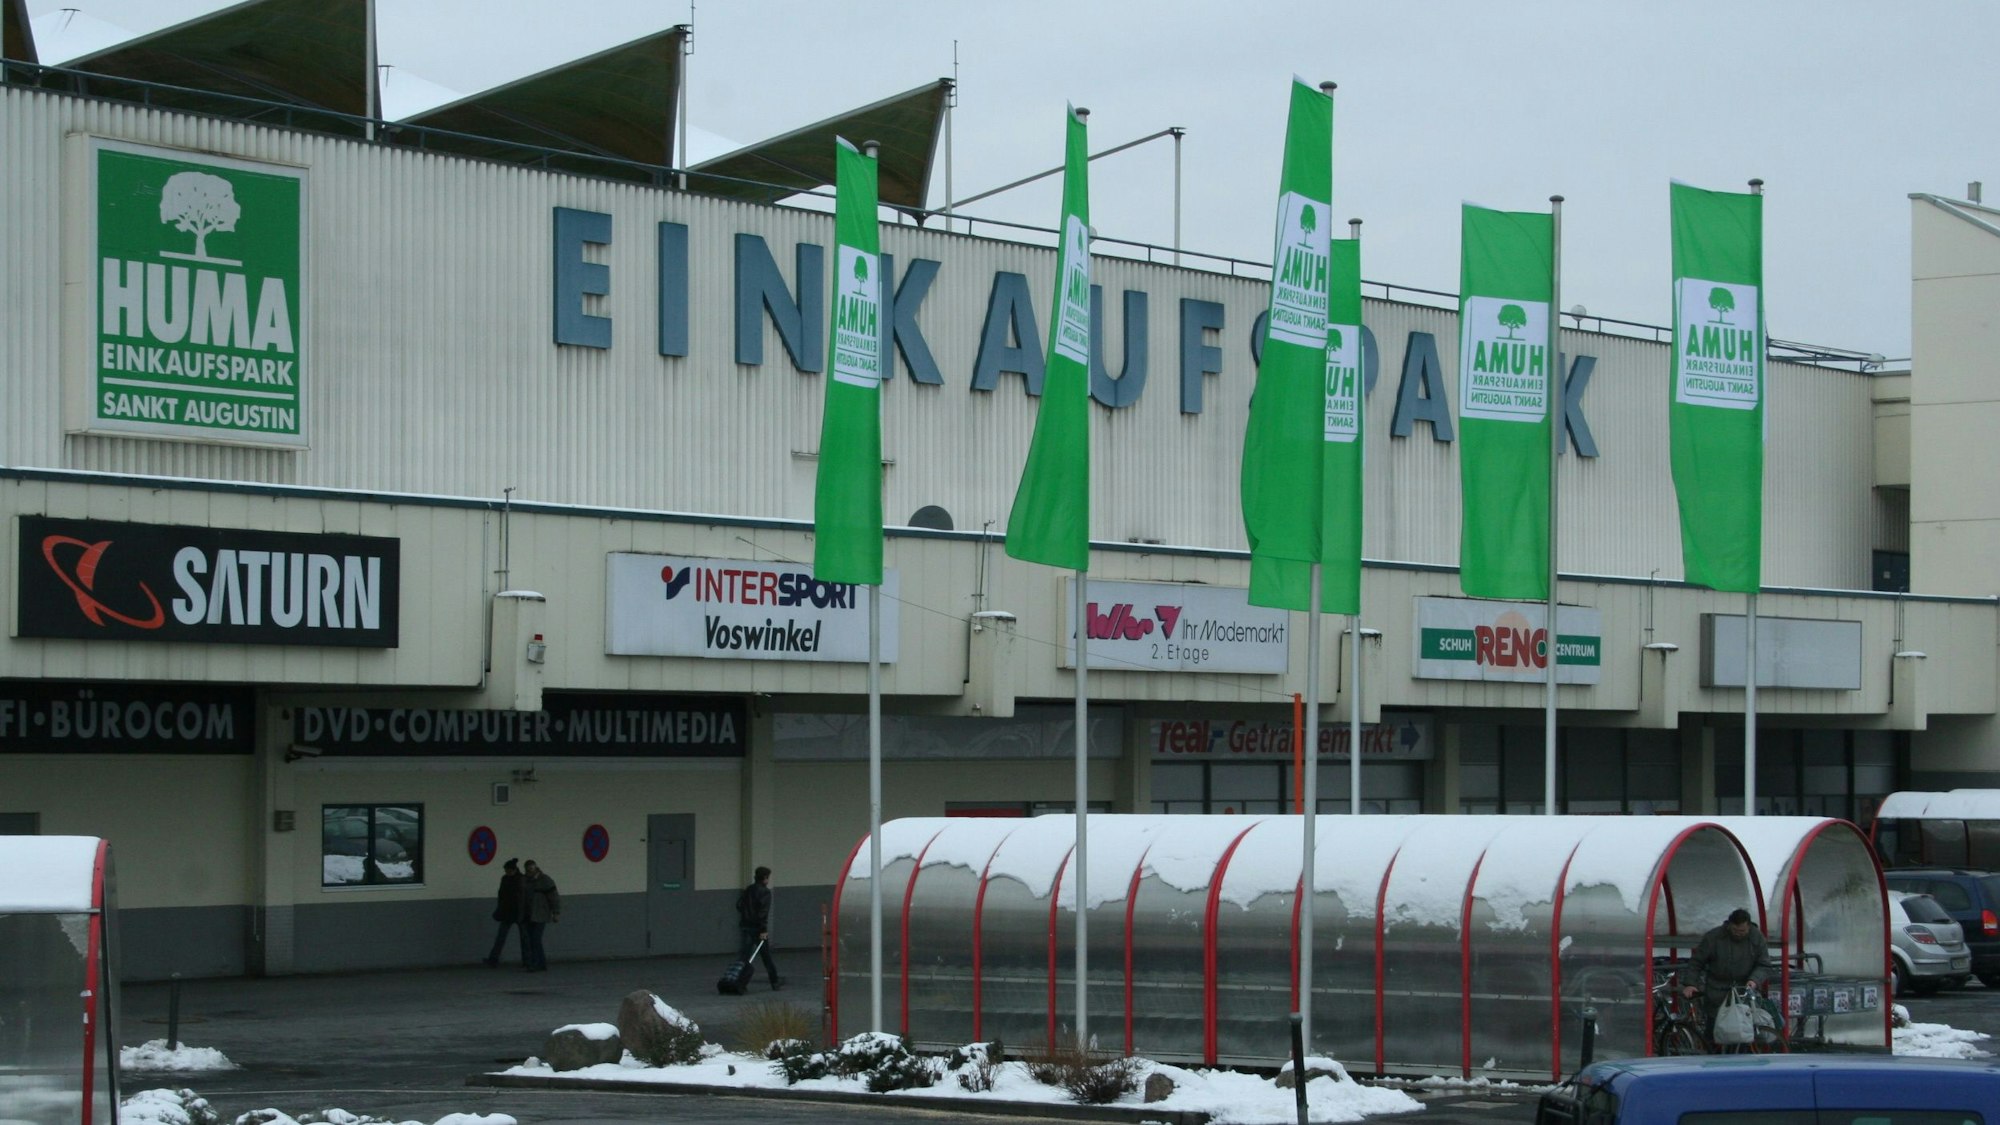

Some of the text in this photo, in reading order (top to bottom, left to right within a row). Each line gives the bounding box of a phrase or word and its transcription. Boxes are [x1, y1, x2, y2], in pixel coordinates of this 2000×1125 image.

[103, 257, 294, 353] HUMA
[553, 206, 1600, 459] EINKAUFAK
[103, 342, 294, 386] EINKAUFSPARK
[103, 392, 295, 430] SANKT AUGUSTIN
[172, 546, 381, 630] SATURN
[696, 567, 856, 609] INTERSPORT
[705, 615, 821, 652] Voswinkel
[1182, 619, 1198, 641] Ihr
[1200, 619, 1284, 644] Modemarkt
[1439, 625, 1595, 669] SCHUH RENO CENTRUM
[1152, 644, 1209, 664] 2. Etage
[51, 689, 234, 740] BÜROCOM
[304, 708, 737, 745] DVD COMPUTER MULTIMEDIA
[1229, 719, 1395, 753] Geträemrkt
